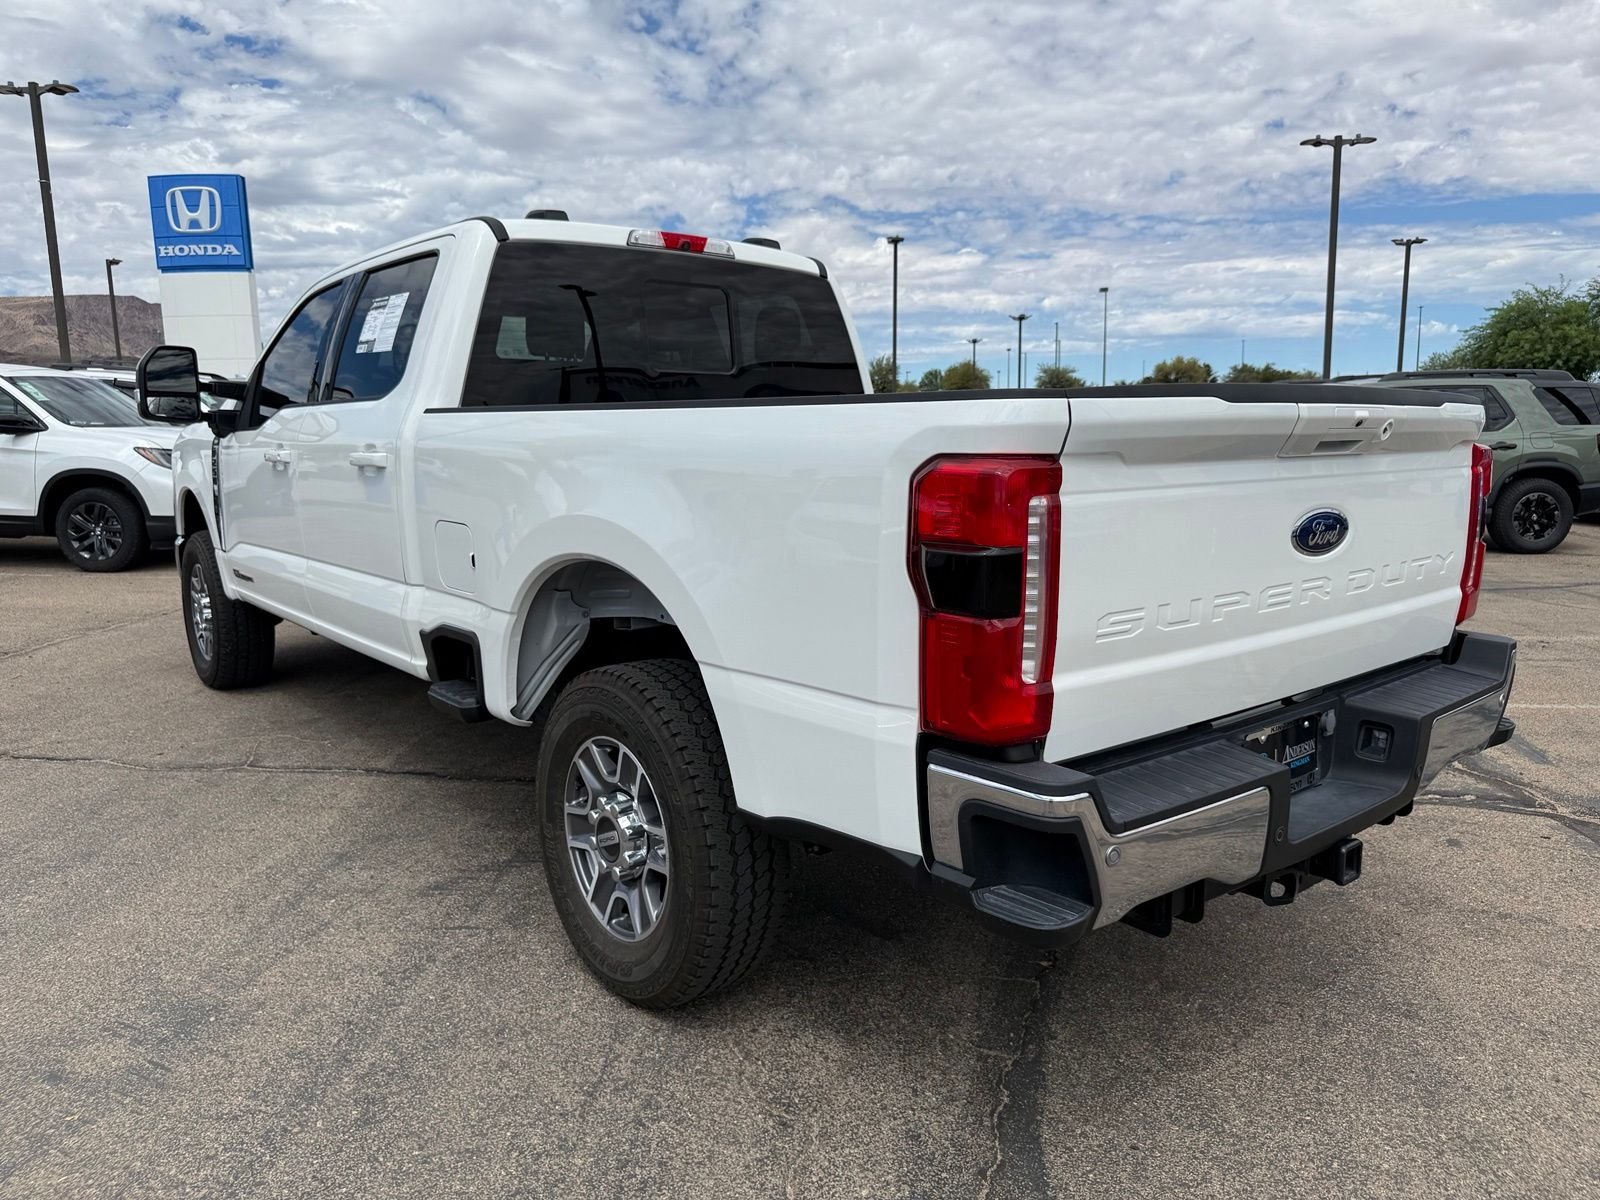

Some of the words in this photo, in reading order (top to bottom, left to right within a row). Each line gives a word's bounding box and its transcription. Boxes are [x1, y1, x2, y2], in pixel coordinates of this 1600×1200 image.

[159, 244, 241, 257] HONDA
[1308, 519, 1340, 546] Ford
[1096, 576, 1332, 643] SUPER
[1346, 551, 1454, 595] DUTY
[599, 835, 616, 843] FORD
